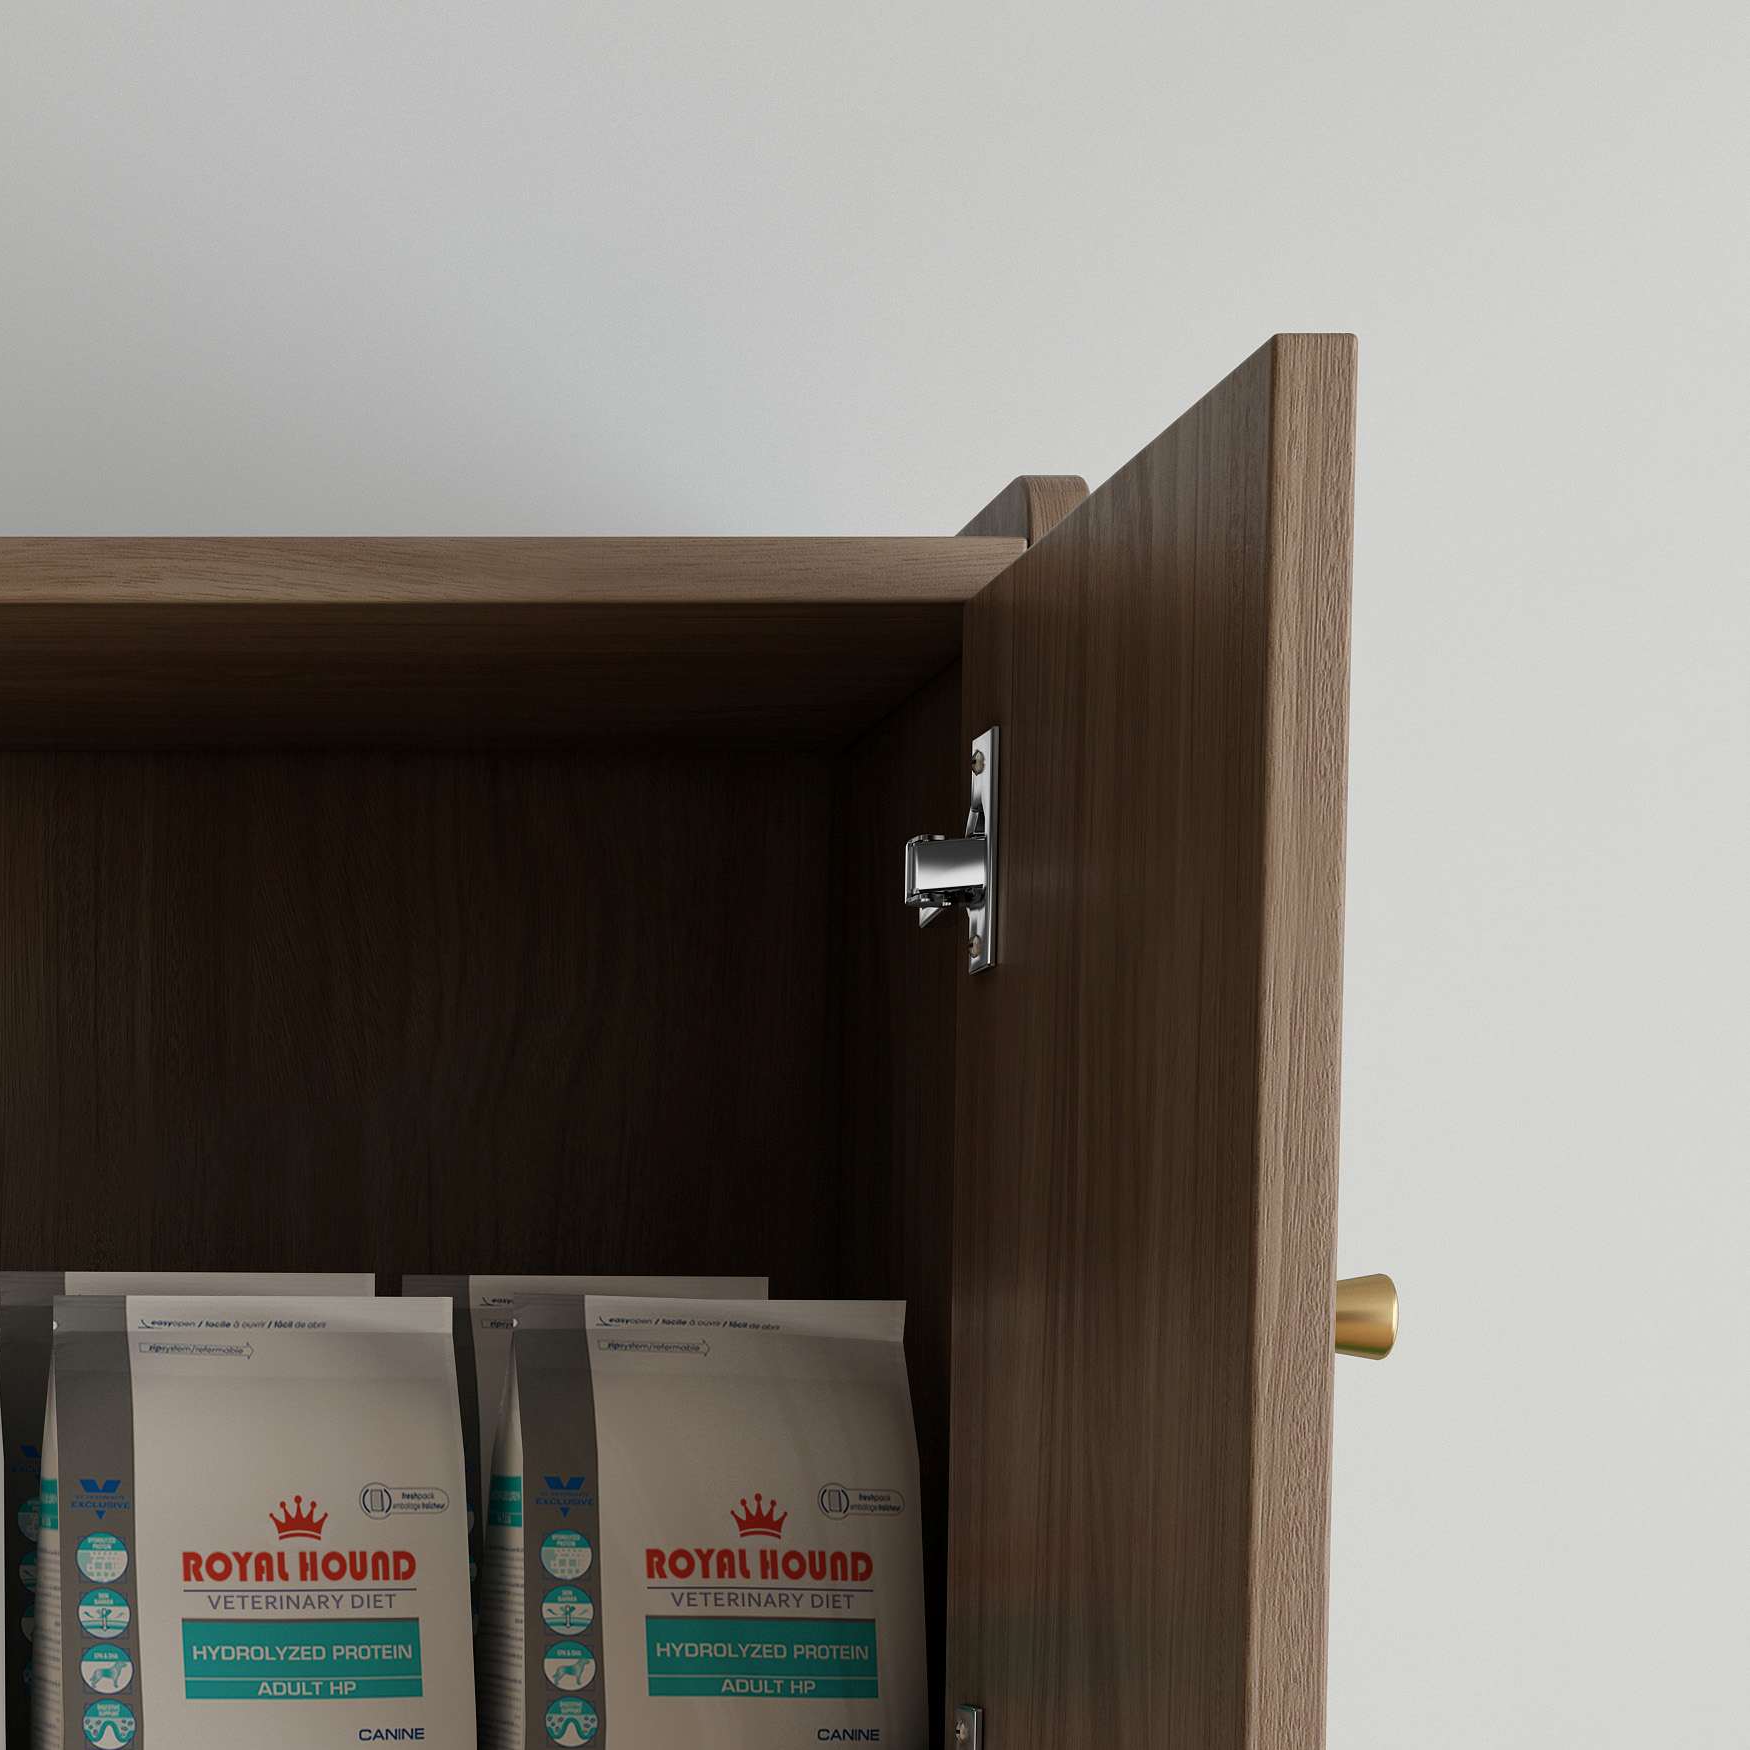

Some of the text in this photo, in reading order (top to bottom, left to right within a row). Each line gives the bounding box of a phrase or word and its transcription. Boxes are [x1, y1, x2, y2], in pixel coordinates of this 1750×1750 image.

[182, 1552, 416, 1583] ROYAL HOUND
[645, 1547, 872, 1581] ROYAL HOUND
[207, 1594, 396, 1610] VETERINARY DIET
[671, 1593, 854, 1609] VETERINARY DIET
[192, 1644, 412, 1660] HYDROLYZED PROTEIN
[657, 1642, 868, 1659] HYDROLYZED PROTEIN
[258, 1681, 356, 1696] ADULT HP
[722, 1679, 816, 1694] ADULT HP
[359, 1728, 424, 1741] CANINE
[818, 1729, 879, 1741] CANINE
